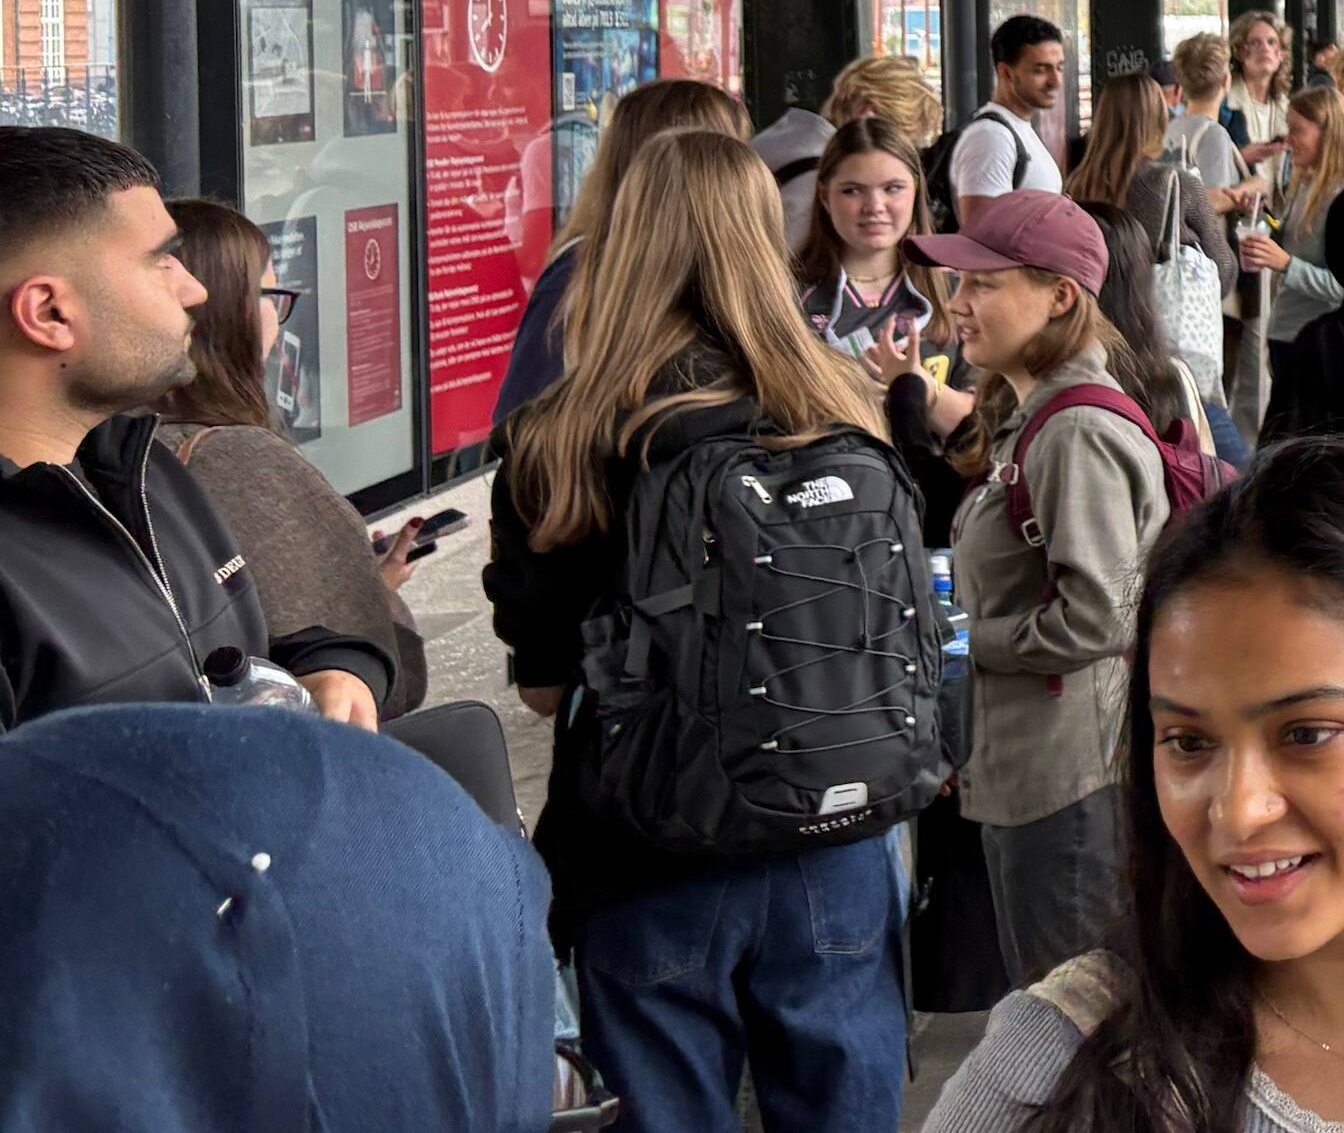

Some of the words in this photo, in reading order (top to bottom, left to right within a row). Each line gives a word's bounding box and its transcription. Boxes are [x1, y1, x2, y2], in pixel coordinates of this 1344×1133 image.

[802, 477, 827, 493] THE
[787, 485, 830, 504] NORTH
[802, 496, 832, 508] FACE
